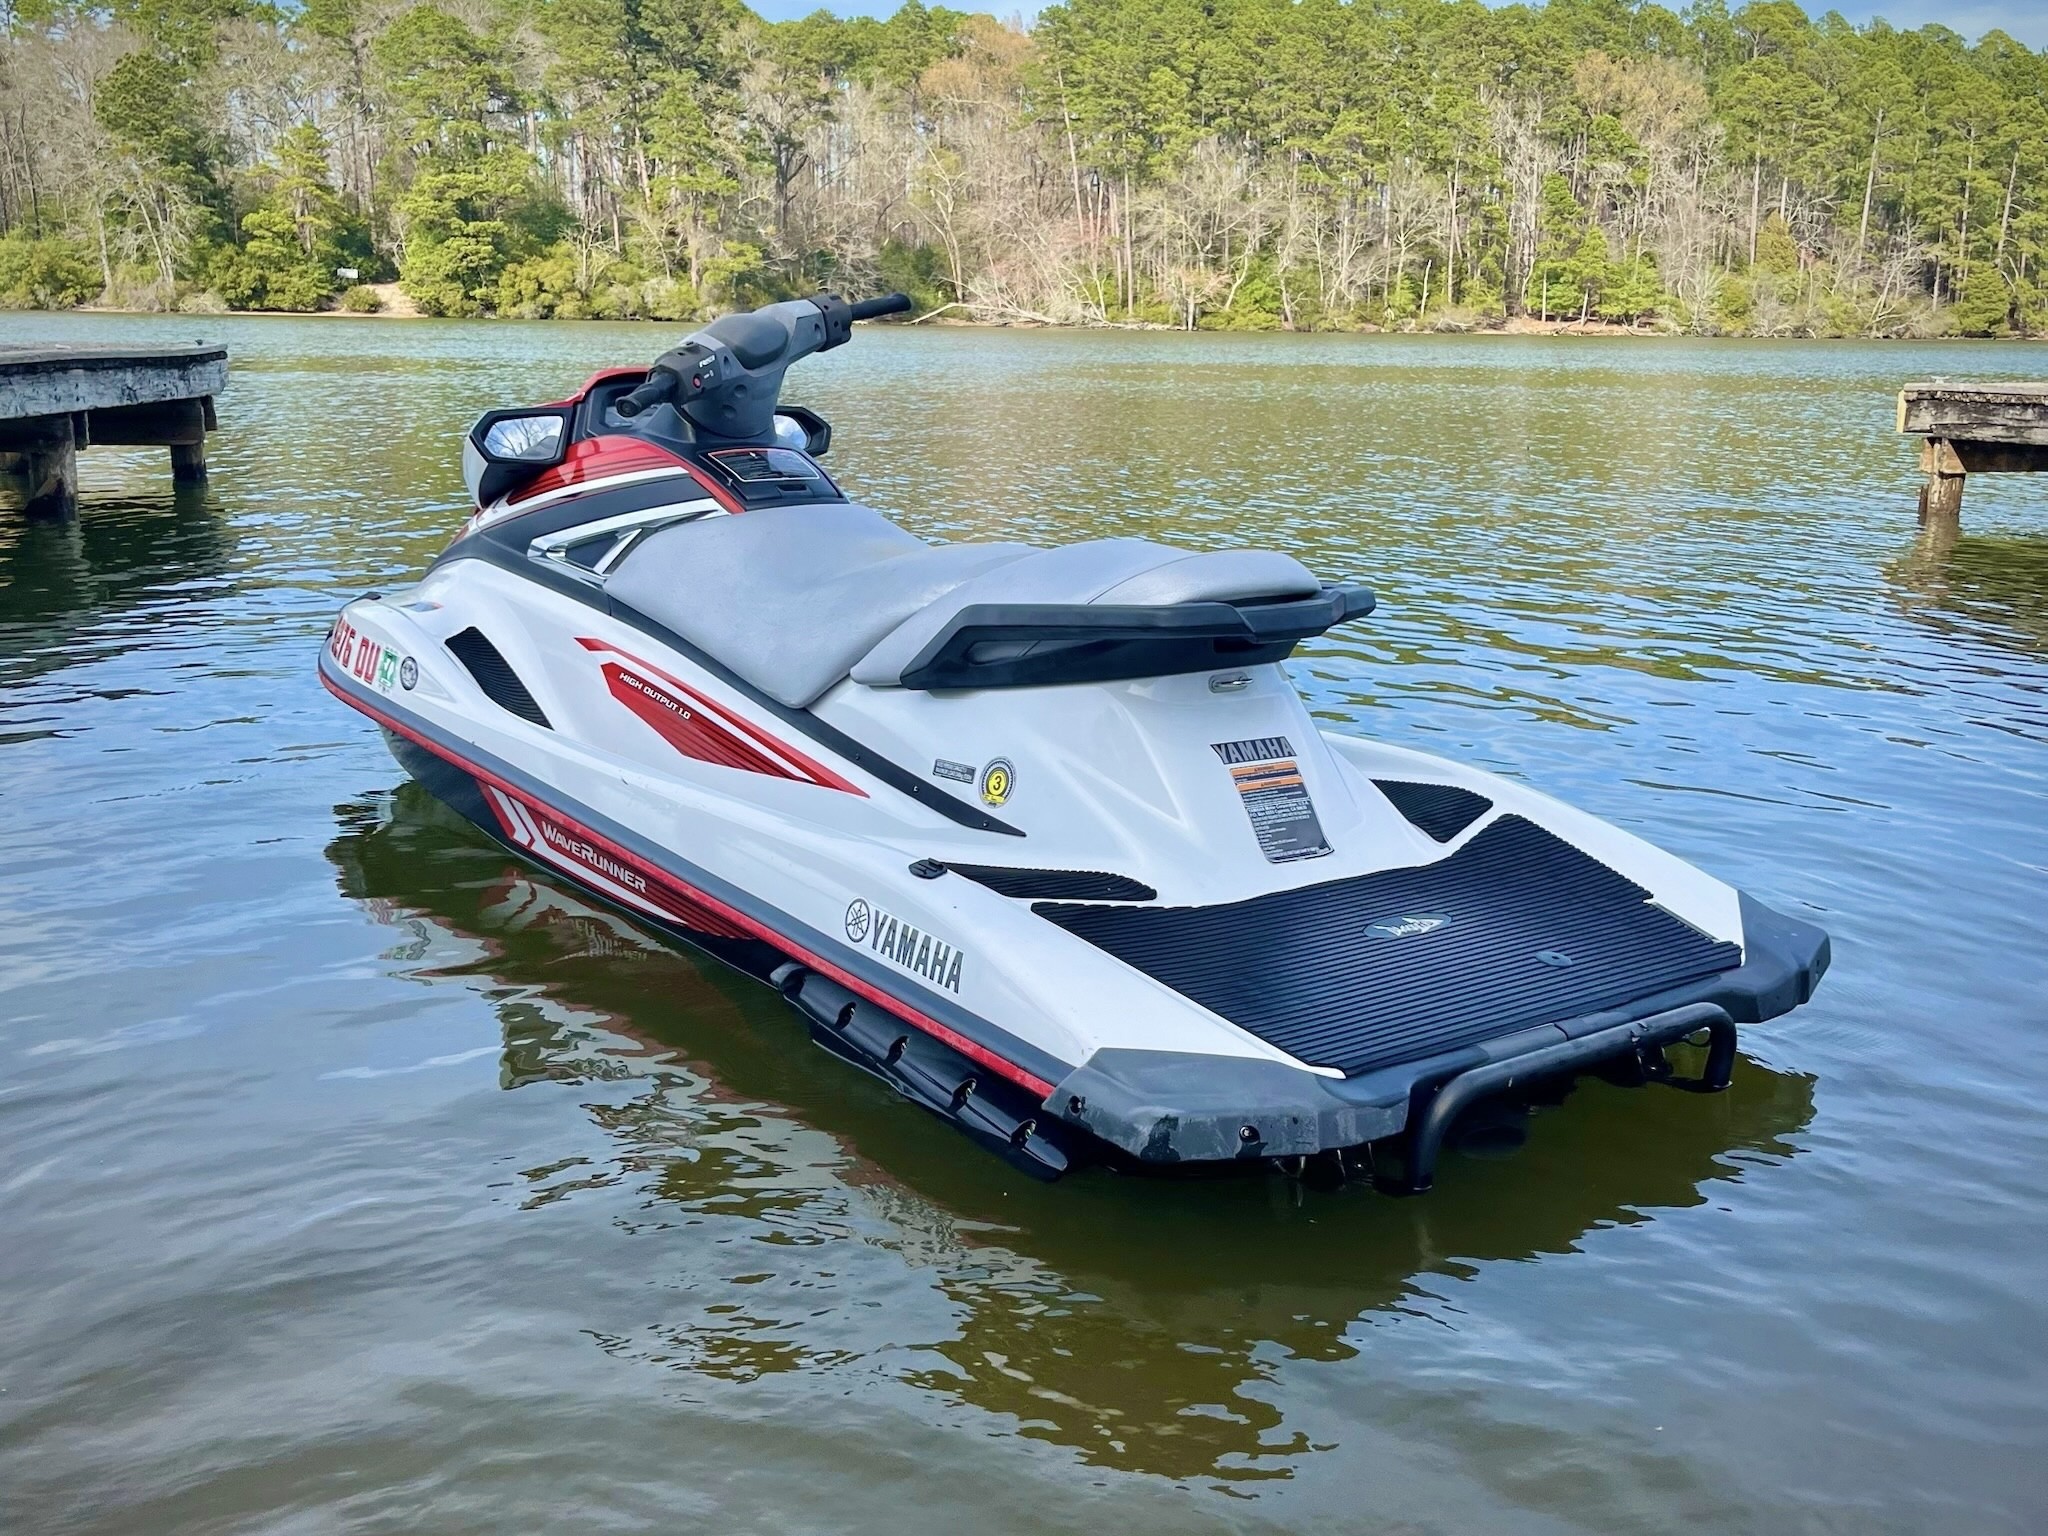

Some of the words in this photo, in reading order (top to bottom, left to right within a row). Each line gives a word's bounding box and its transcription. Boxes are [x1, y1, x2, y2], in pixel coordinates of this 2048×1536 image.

[619, 672, 643, 690] HIGH
[643, 686, 679, 711] OUTPUT
[1212, 737, 1296, 764] YAMAHA
[993, 775, 1002, 791] 3
[872, 909, 964, 994] YAMAHA
